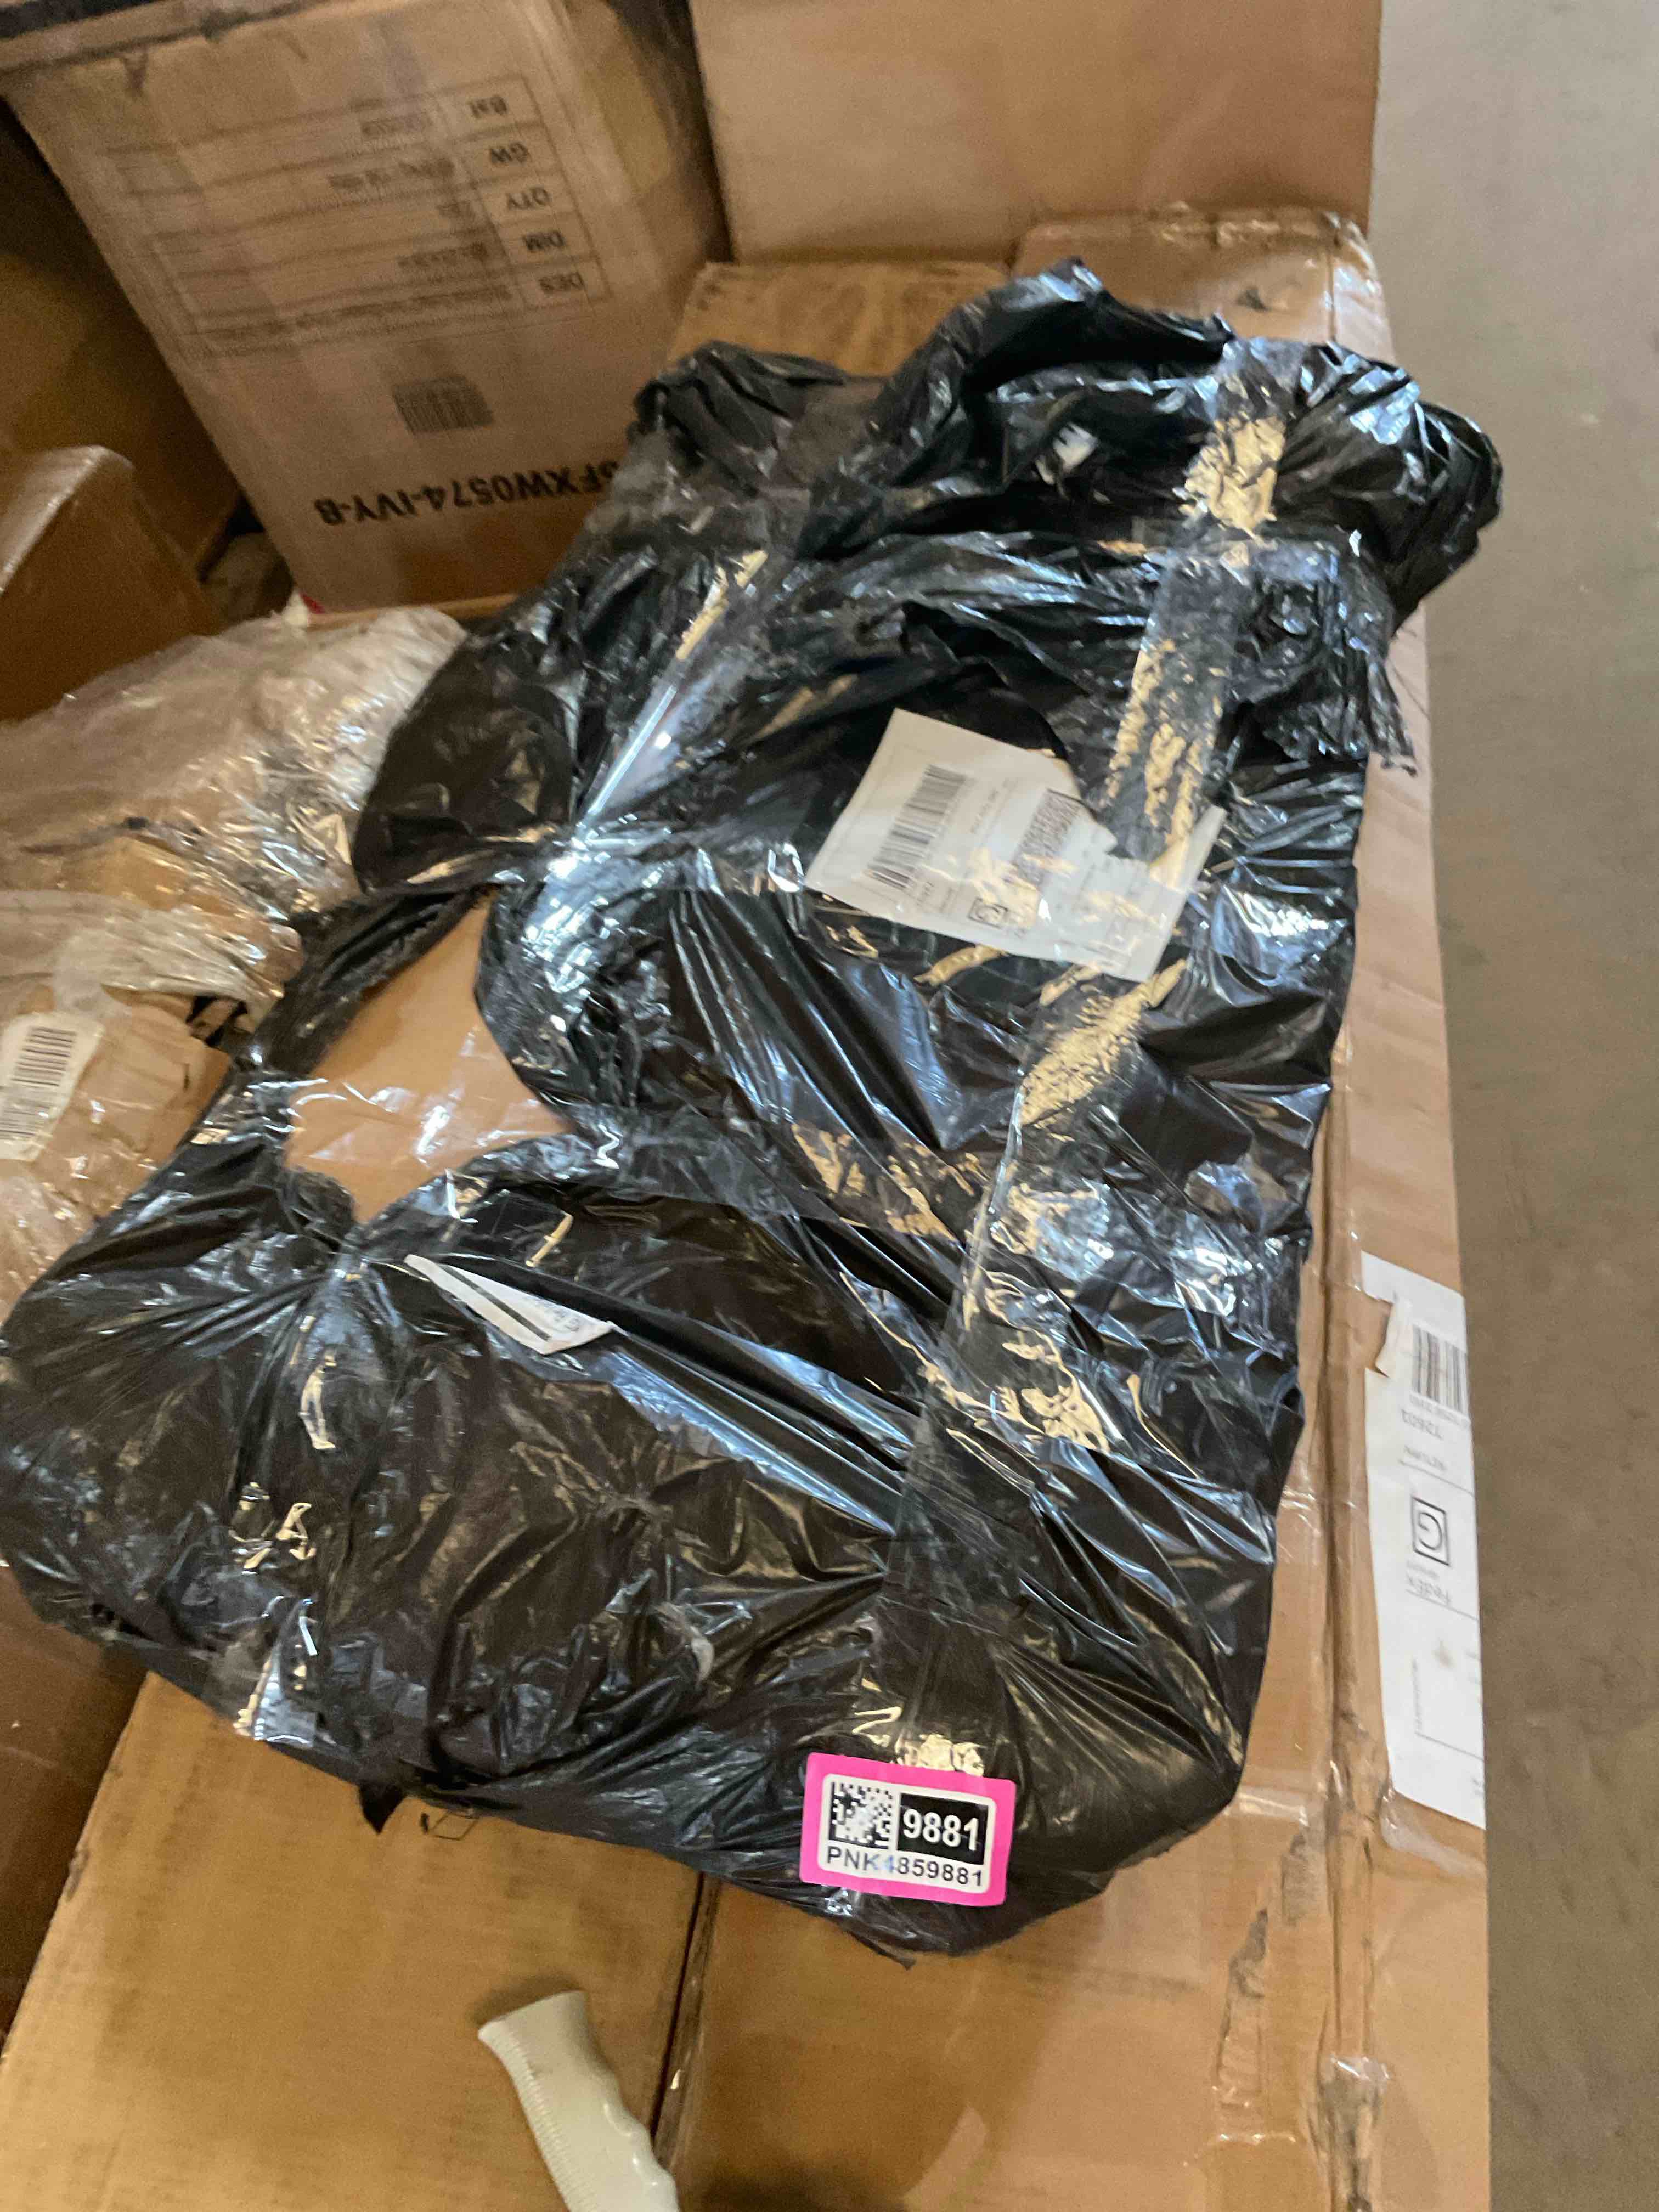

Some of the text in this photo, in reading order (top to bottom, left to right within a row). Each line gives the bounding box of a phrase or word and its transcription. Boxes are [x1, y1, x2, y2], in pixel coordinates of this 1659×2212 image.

[488, 142, 533, 168] GW
[505, 187, 552, 211] QTY
[521, 229, 567, 254] DIM
[903, 1809, 979, 1852] 9881
[827, 1846, 983, 1887] PNK4859881
